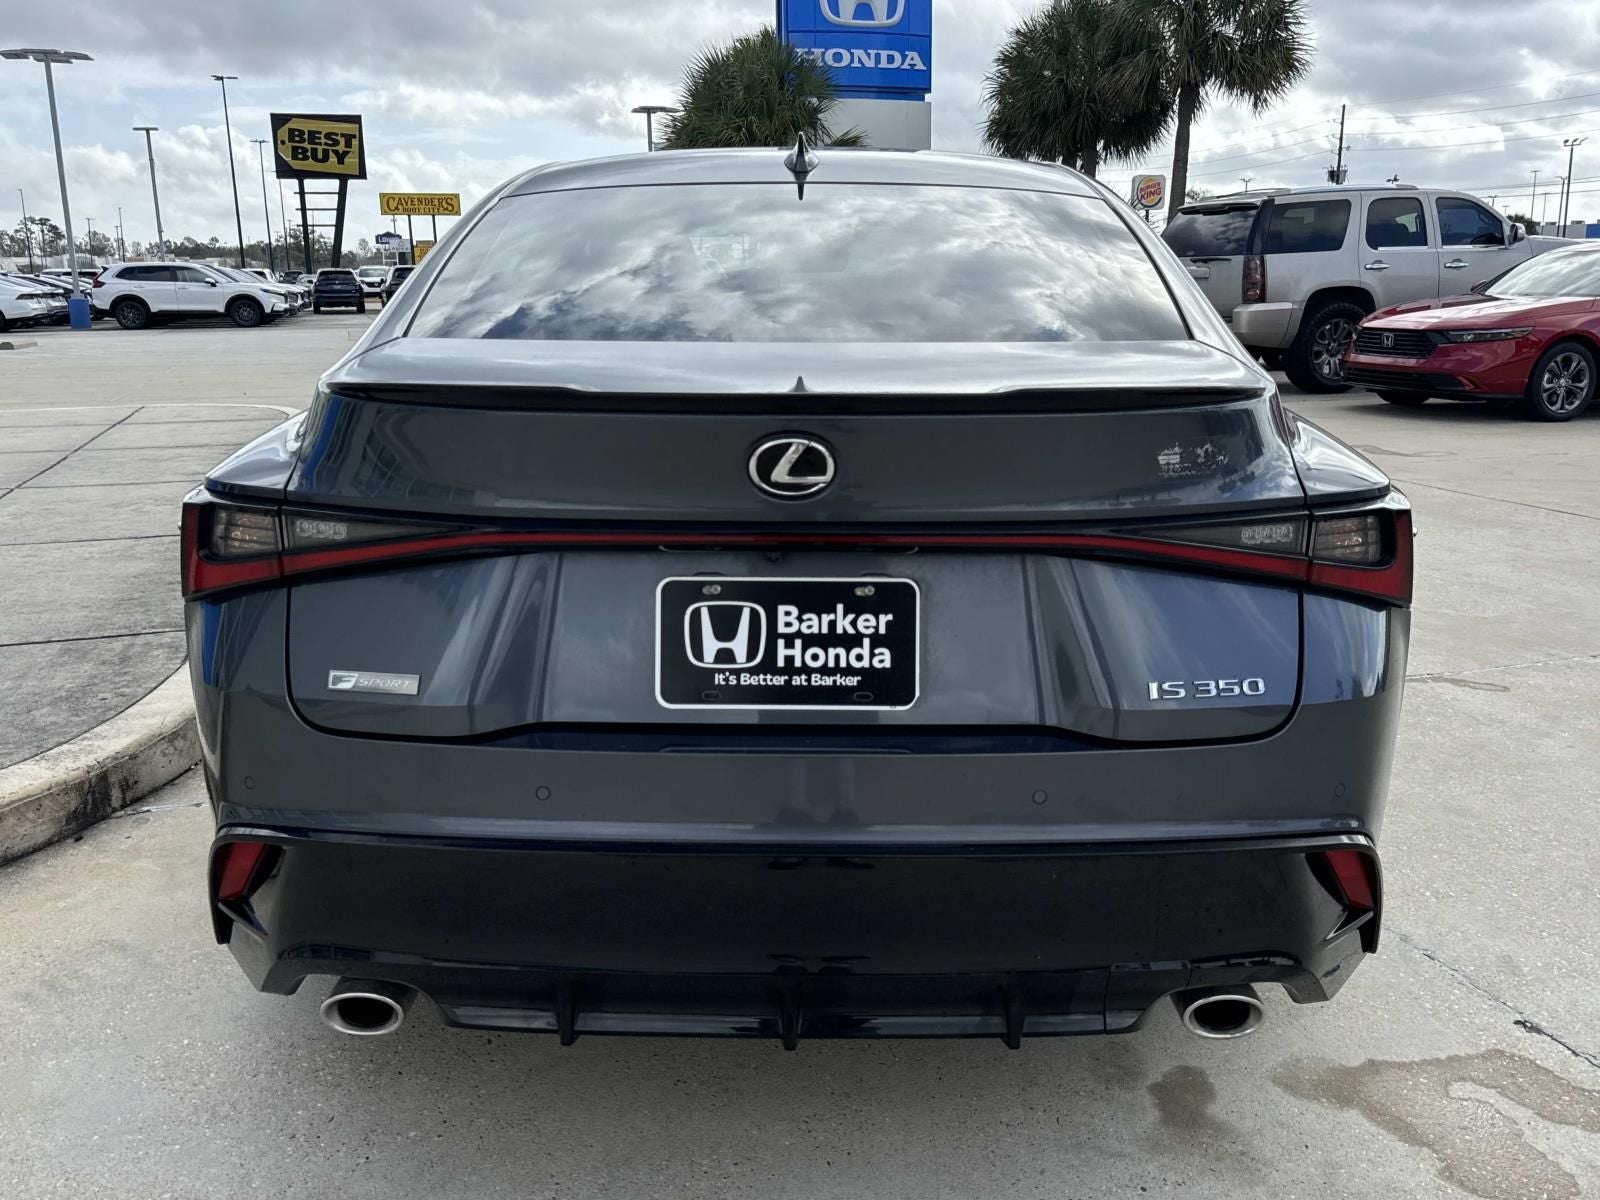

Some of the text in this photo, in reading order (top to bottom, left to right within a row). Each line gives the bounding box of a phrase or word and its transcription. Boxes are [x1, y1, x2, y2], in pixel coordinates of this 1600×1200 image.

[794, 47, 927, 70] HONDA
[287, 127, 357, 149] BEST
[291, 145, 352, 165] BUY
[386, 196, 455, 212] CAVENDER'S
[1140, 187, 1162, 201] KING
[776, 603, 893, 634] Barker
[776, 637, 892, 668] Honda
[359, 678, 413, 688] SPORT
[714, 671, 861, 686] It's Better at Barker
[1148, 678, 1266, 700] IS 350
